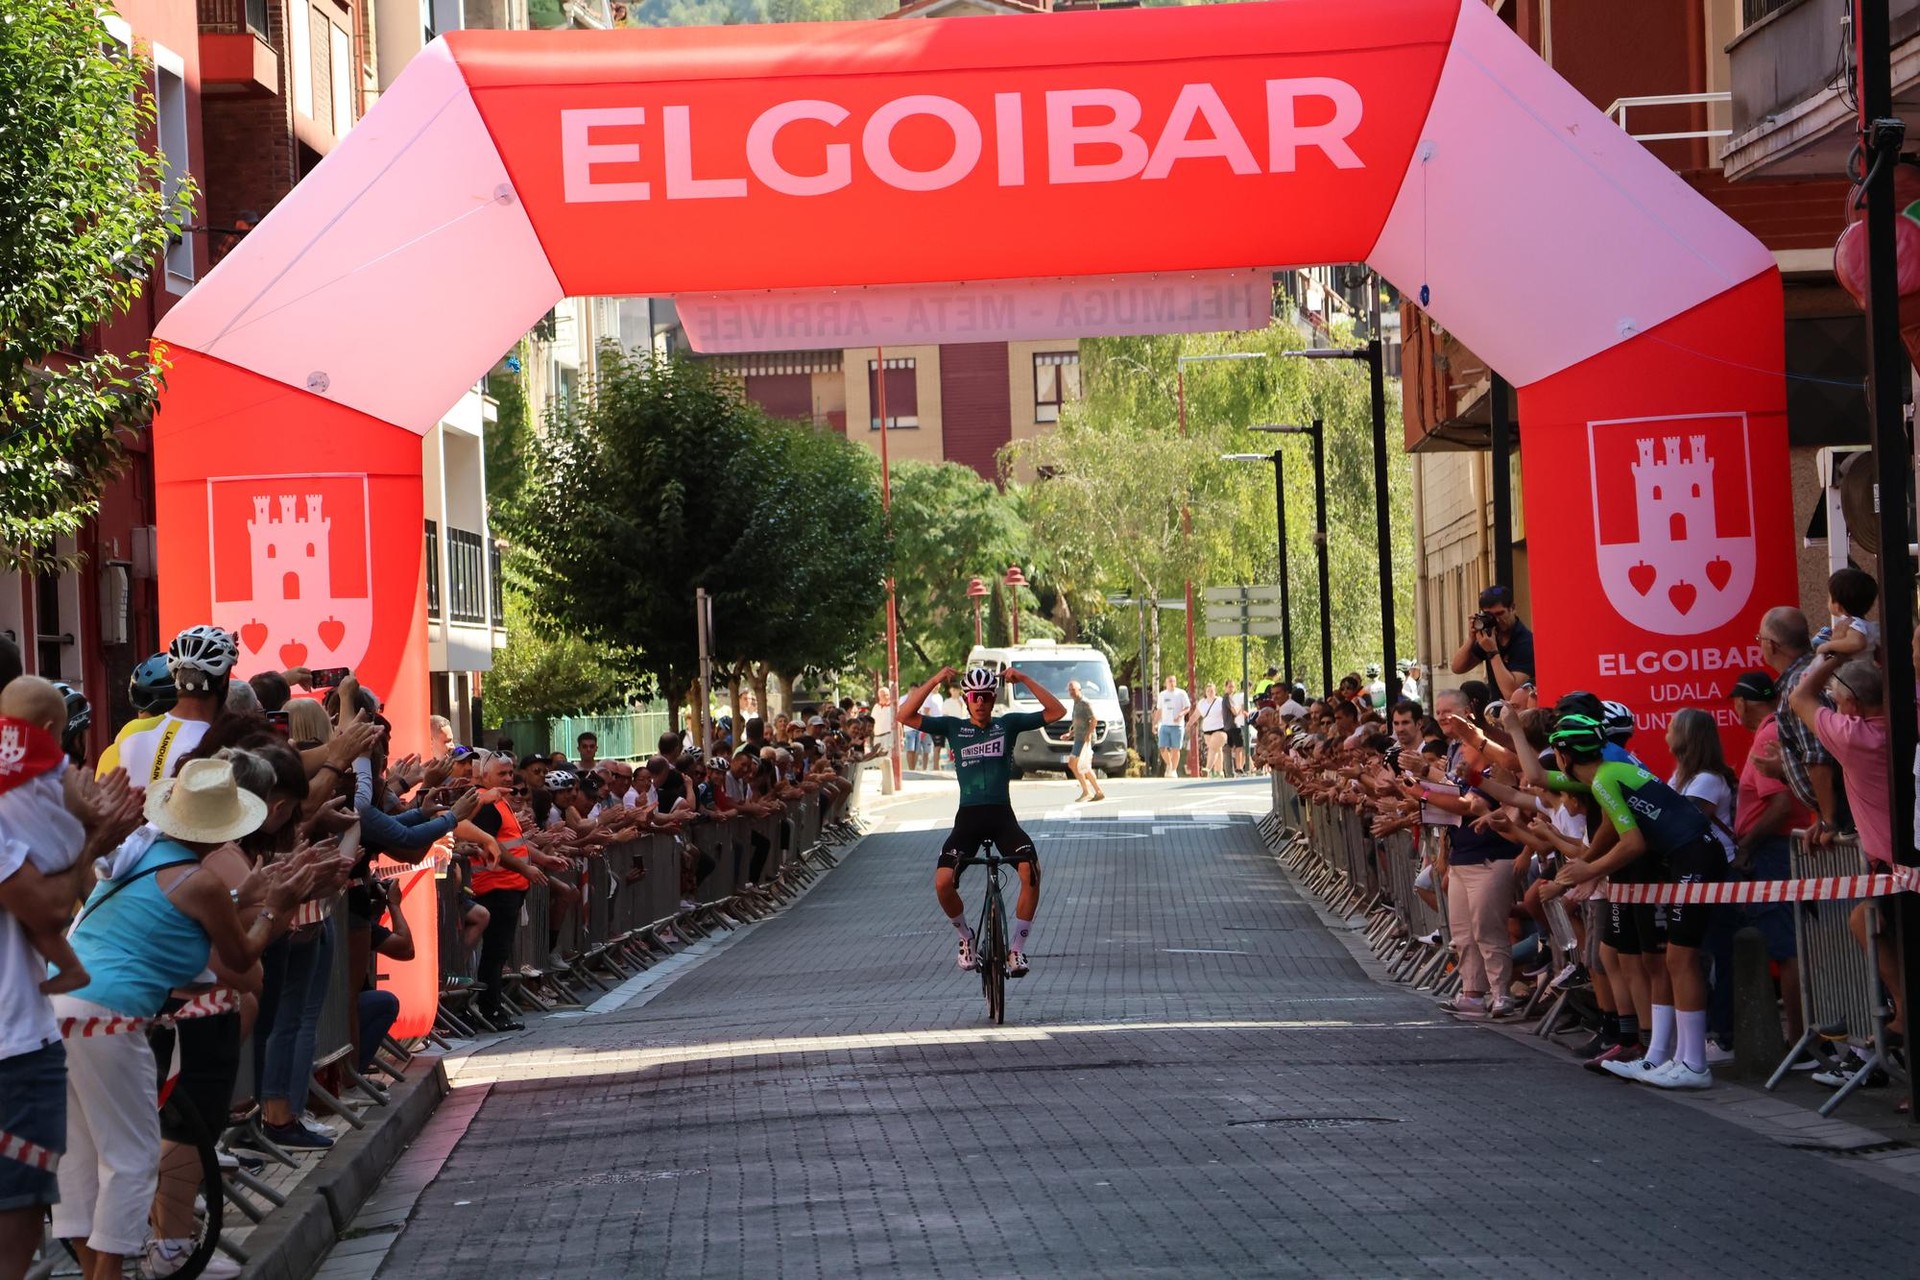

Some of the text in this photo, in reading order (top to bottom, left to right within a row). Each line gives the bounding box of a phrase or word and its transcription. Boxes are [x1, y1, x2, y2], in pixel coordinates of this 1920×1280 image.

[560, 76, 1366, 204] ELGOIBAR
[1598, 645, 1764, 676] ELGOIBAR
[1651, 682, 1722, 702] UDALA
[962, 741, 1001, 758] FINISHER
